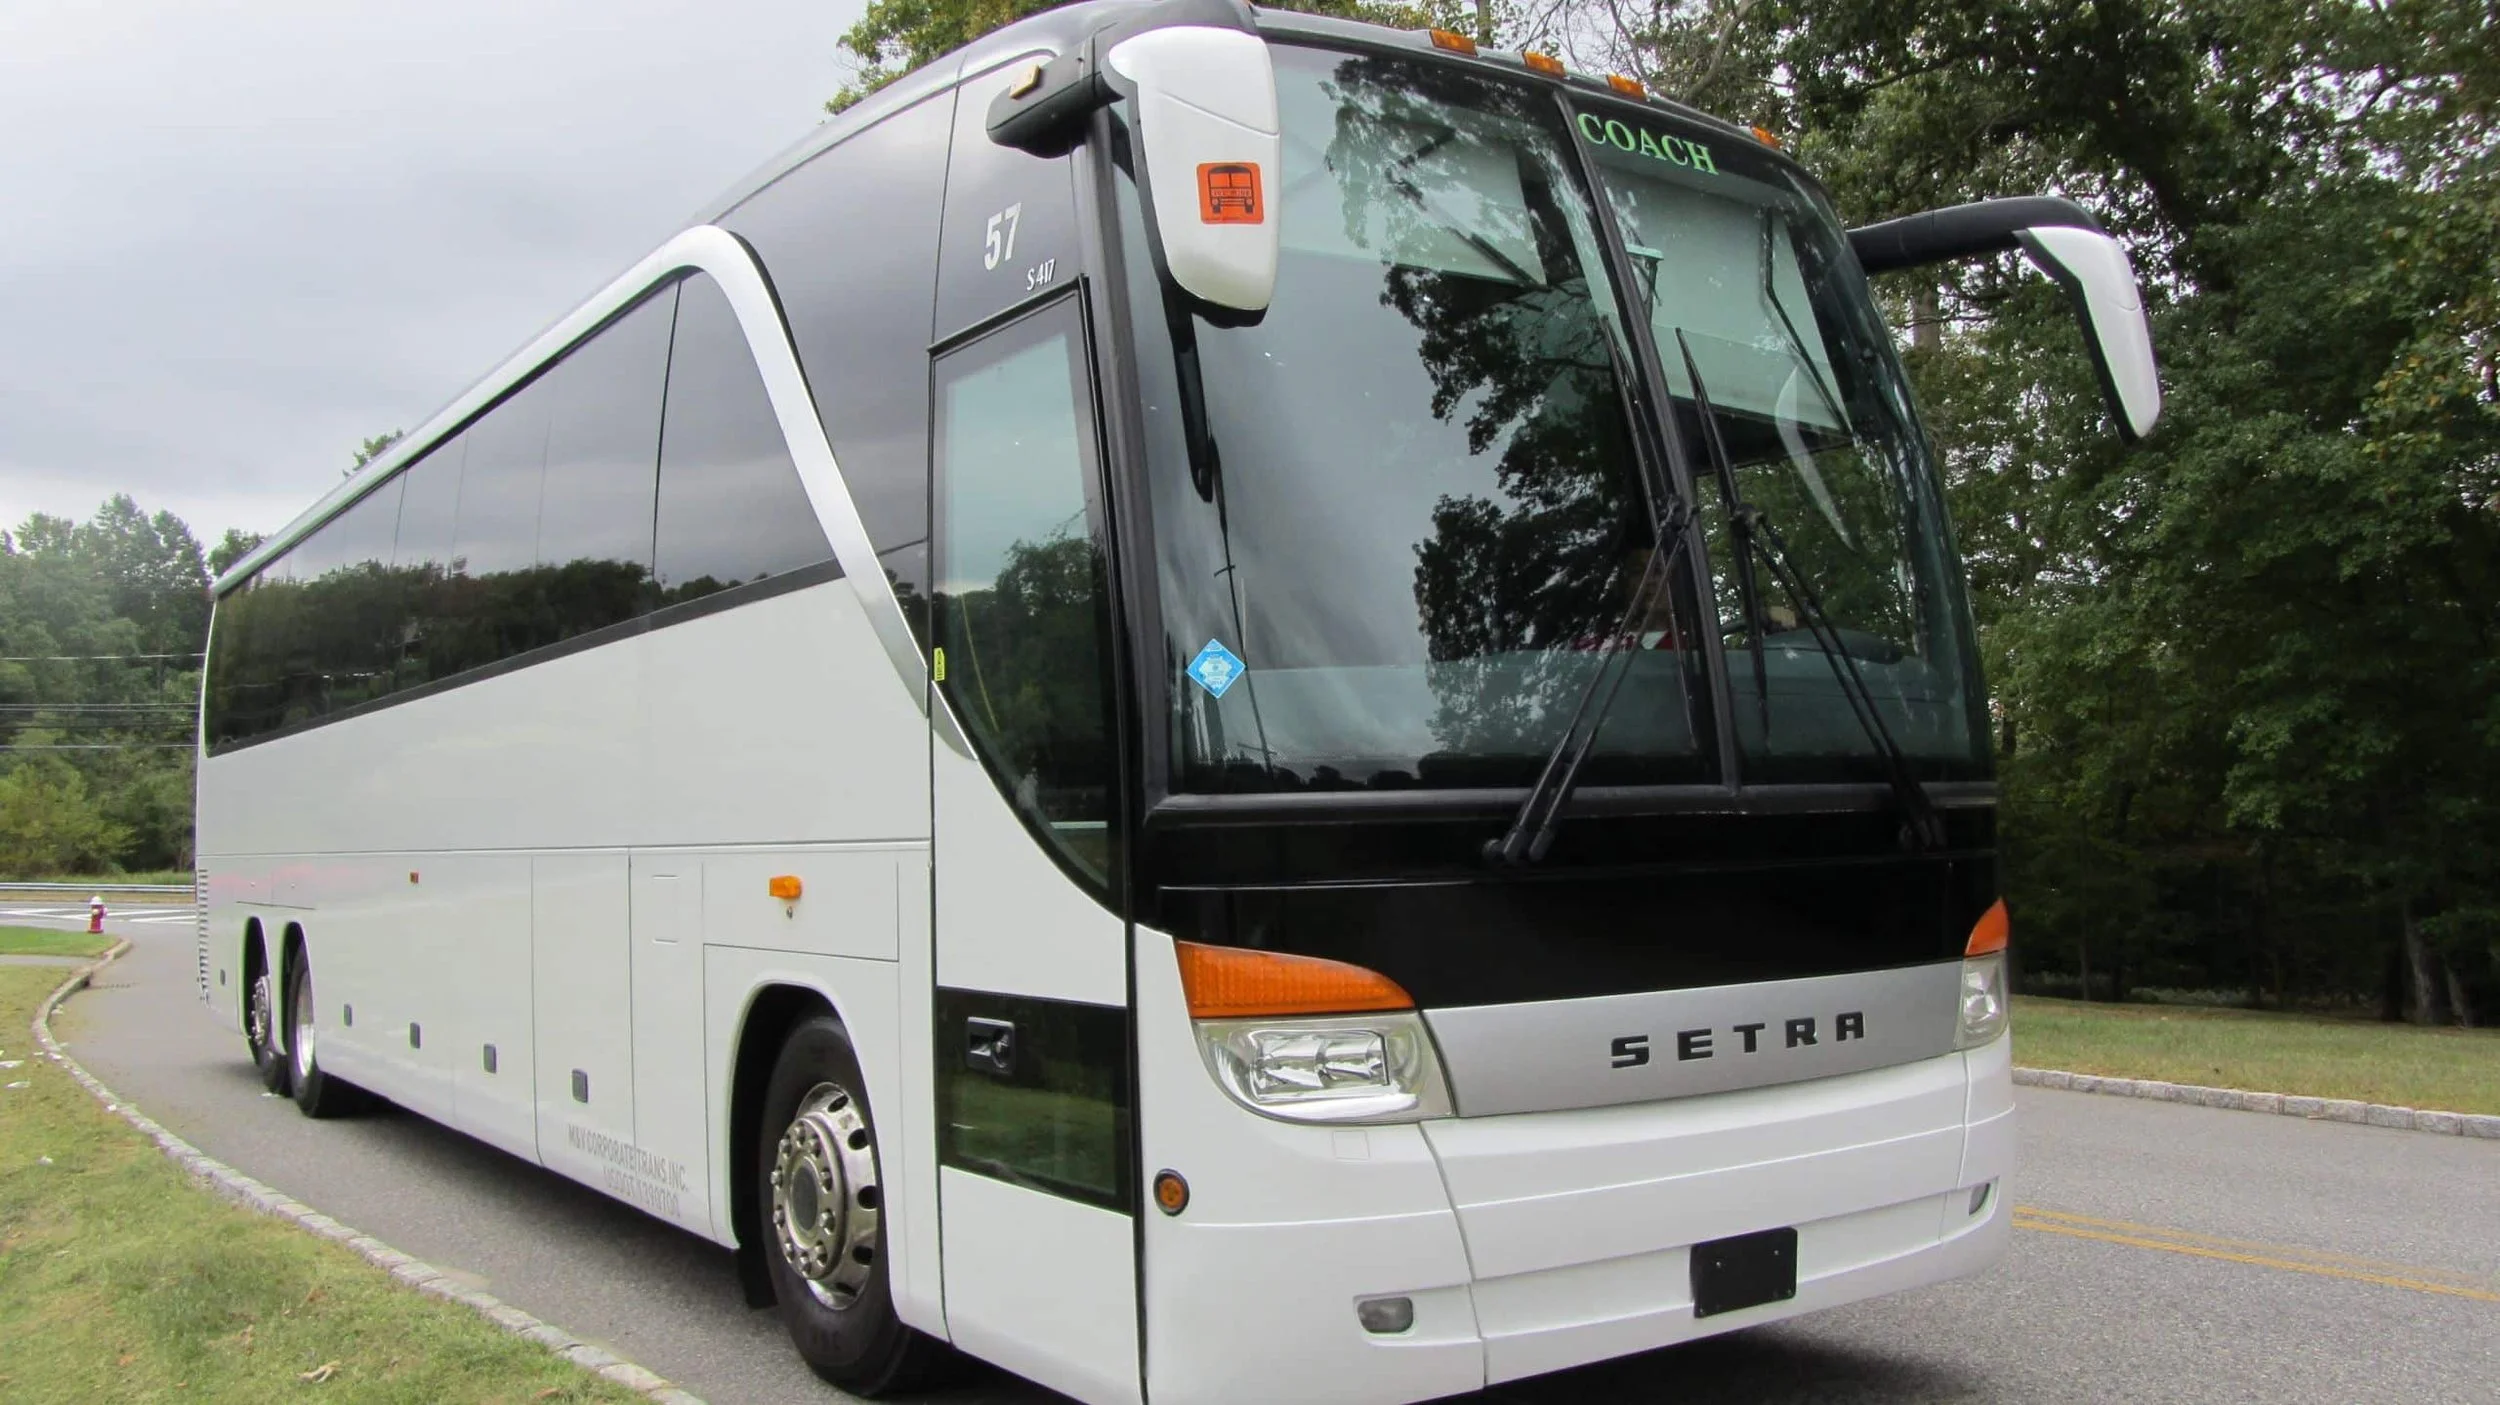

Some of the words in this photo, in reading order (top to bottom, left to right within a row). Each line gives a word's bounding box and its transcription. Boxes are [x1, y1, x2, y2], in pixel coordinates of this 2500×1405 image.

[1577, 113, 1719, 175] COACH
[984, 202, 1022, 270] 57
[1611, 1011, 1865, 1068] SETRA
[637, 1148, 666, 1183] TRANS
